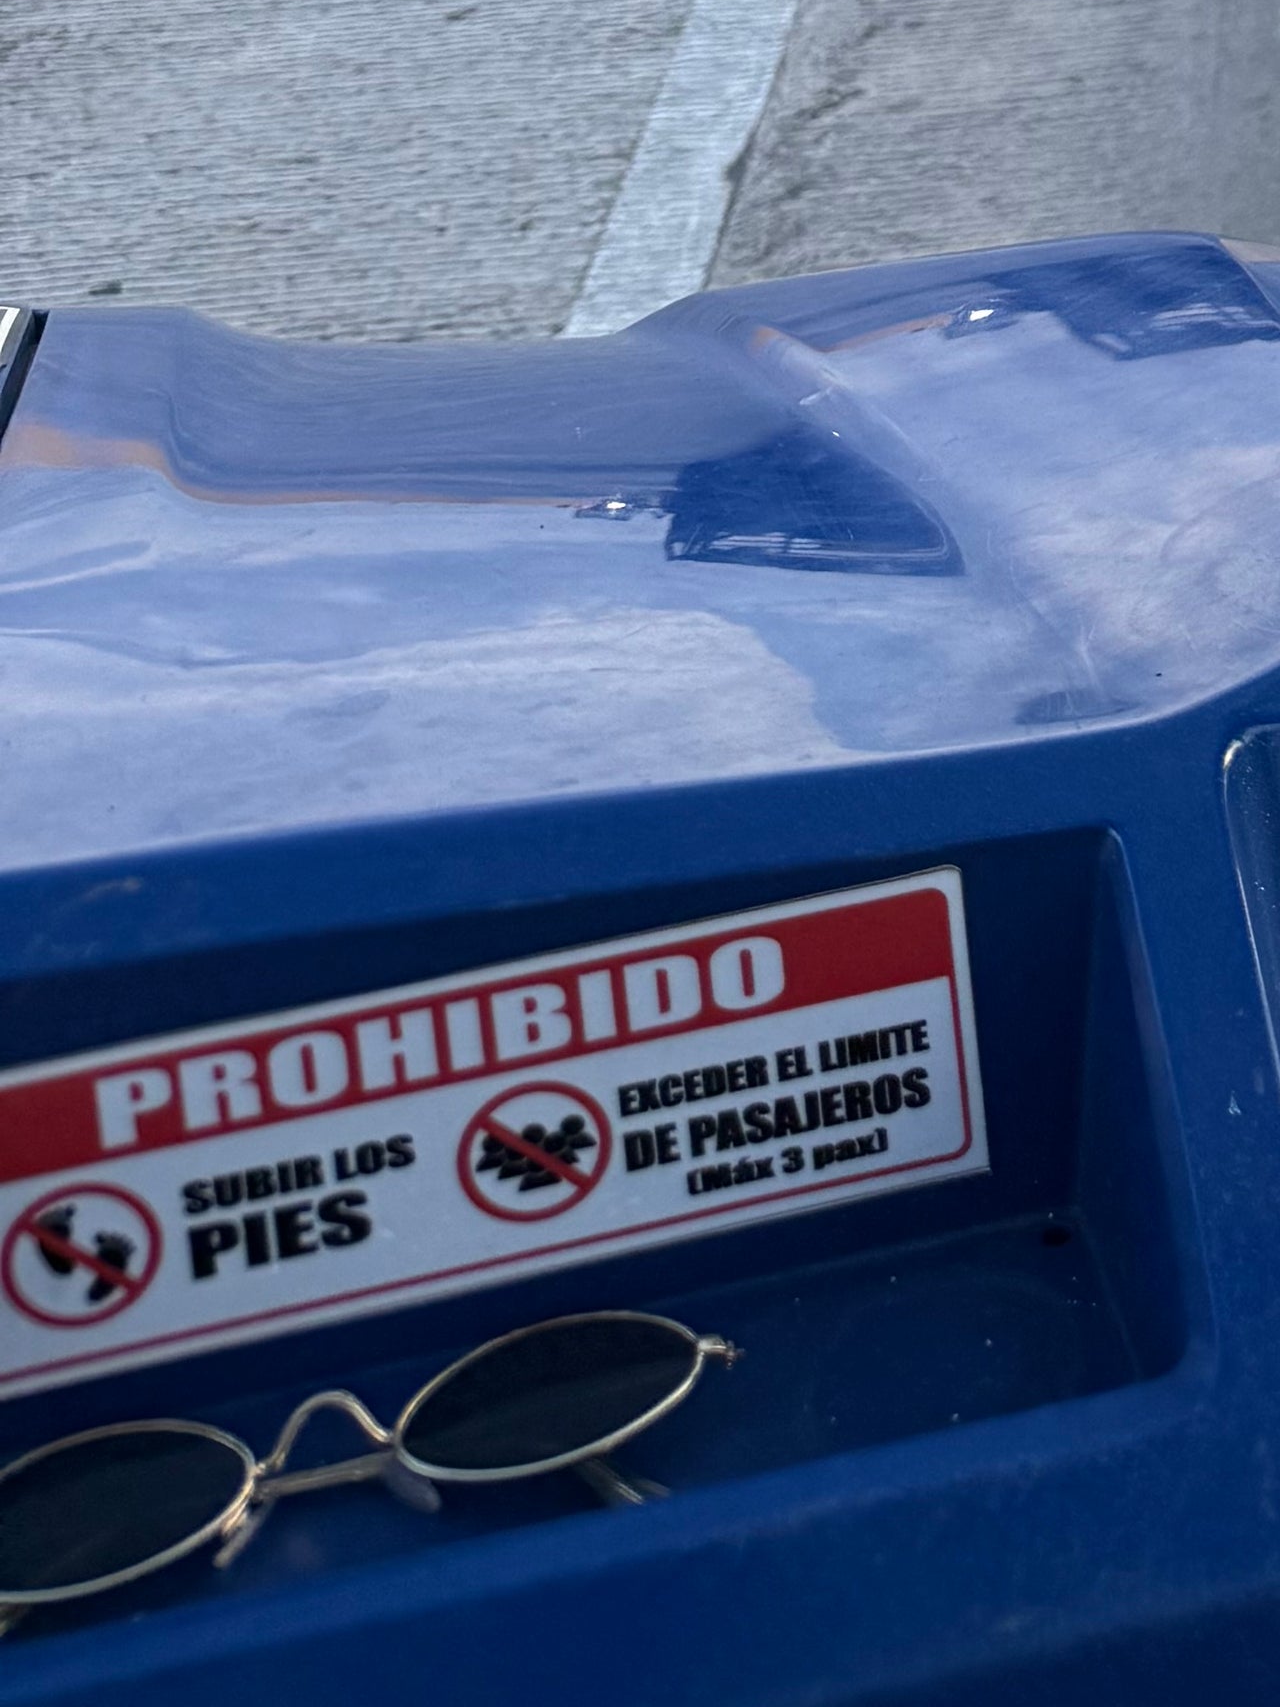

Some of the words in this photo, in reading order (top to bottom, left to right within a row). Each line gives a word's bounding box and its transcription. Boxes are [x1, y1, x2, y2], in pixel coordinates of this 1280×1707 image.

[95, 935, 786, 1151] PROHIBIDO
[617, 1054, 770, 1117] EXCEDER
[775, 1044, 813, 1082] EL
[818, 1018, 931, 1073] LIMITE
[622, 1122, 681, 1172] DE
[688, 1066, 931, 1158] PASAJEROS
[780, 1144, 805, 1174] 3
[182, 1154, 325, 1215] SUBIR
[333, 1133, 417, 1182] LOS
[187, 1188, 373, 1280] PIES
